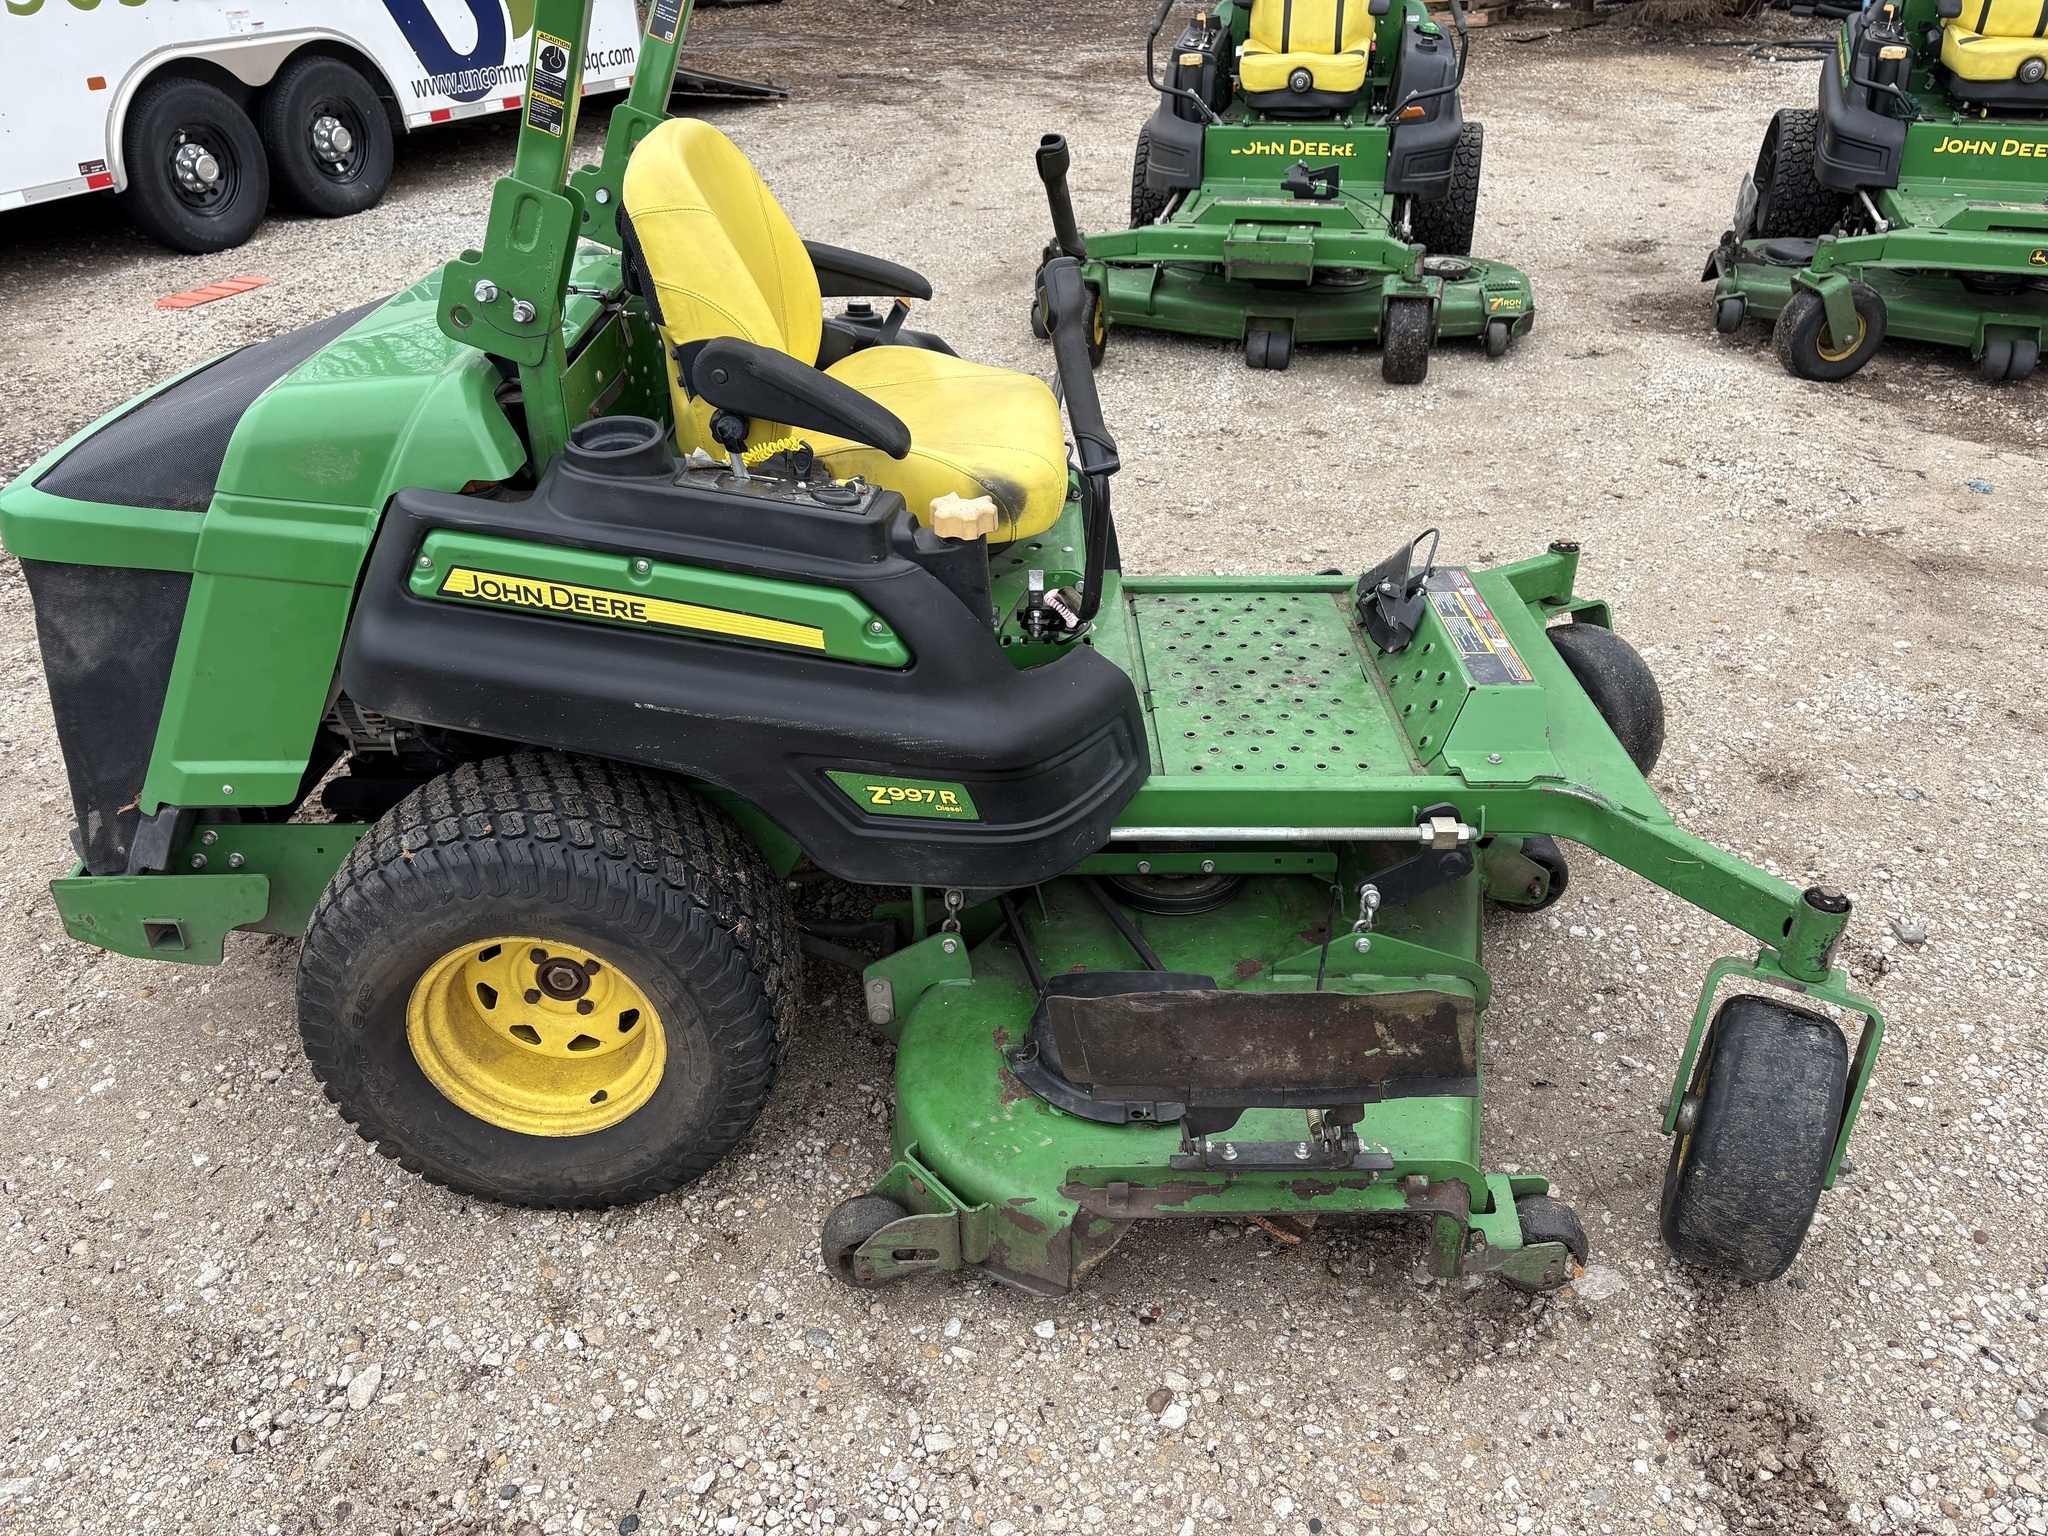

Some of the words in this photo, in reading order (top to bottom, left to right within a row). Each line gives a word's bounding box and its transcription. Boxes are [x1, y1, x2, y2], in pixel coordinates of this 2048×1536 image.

[543, 33, 571, 49] CAUTION
[1230, 141, 1285, 155] OHN
[1933, 136, 1997, 155] JOHN
[465, 574, 543, 605] JOHN
[549, 586, 648, 621] DEERE
[935, 804, 963, 813] Diesel
